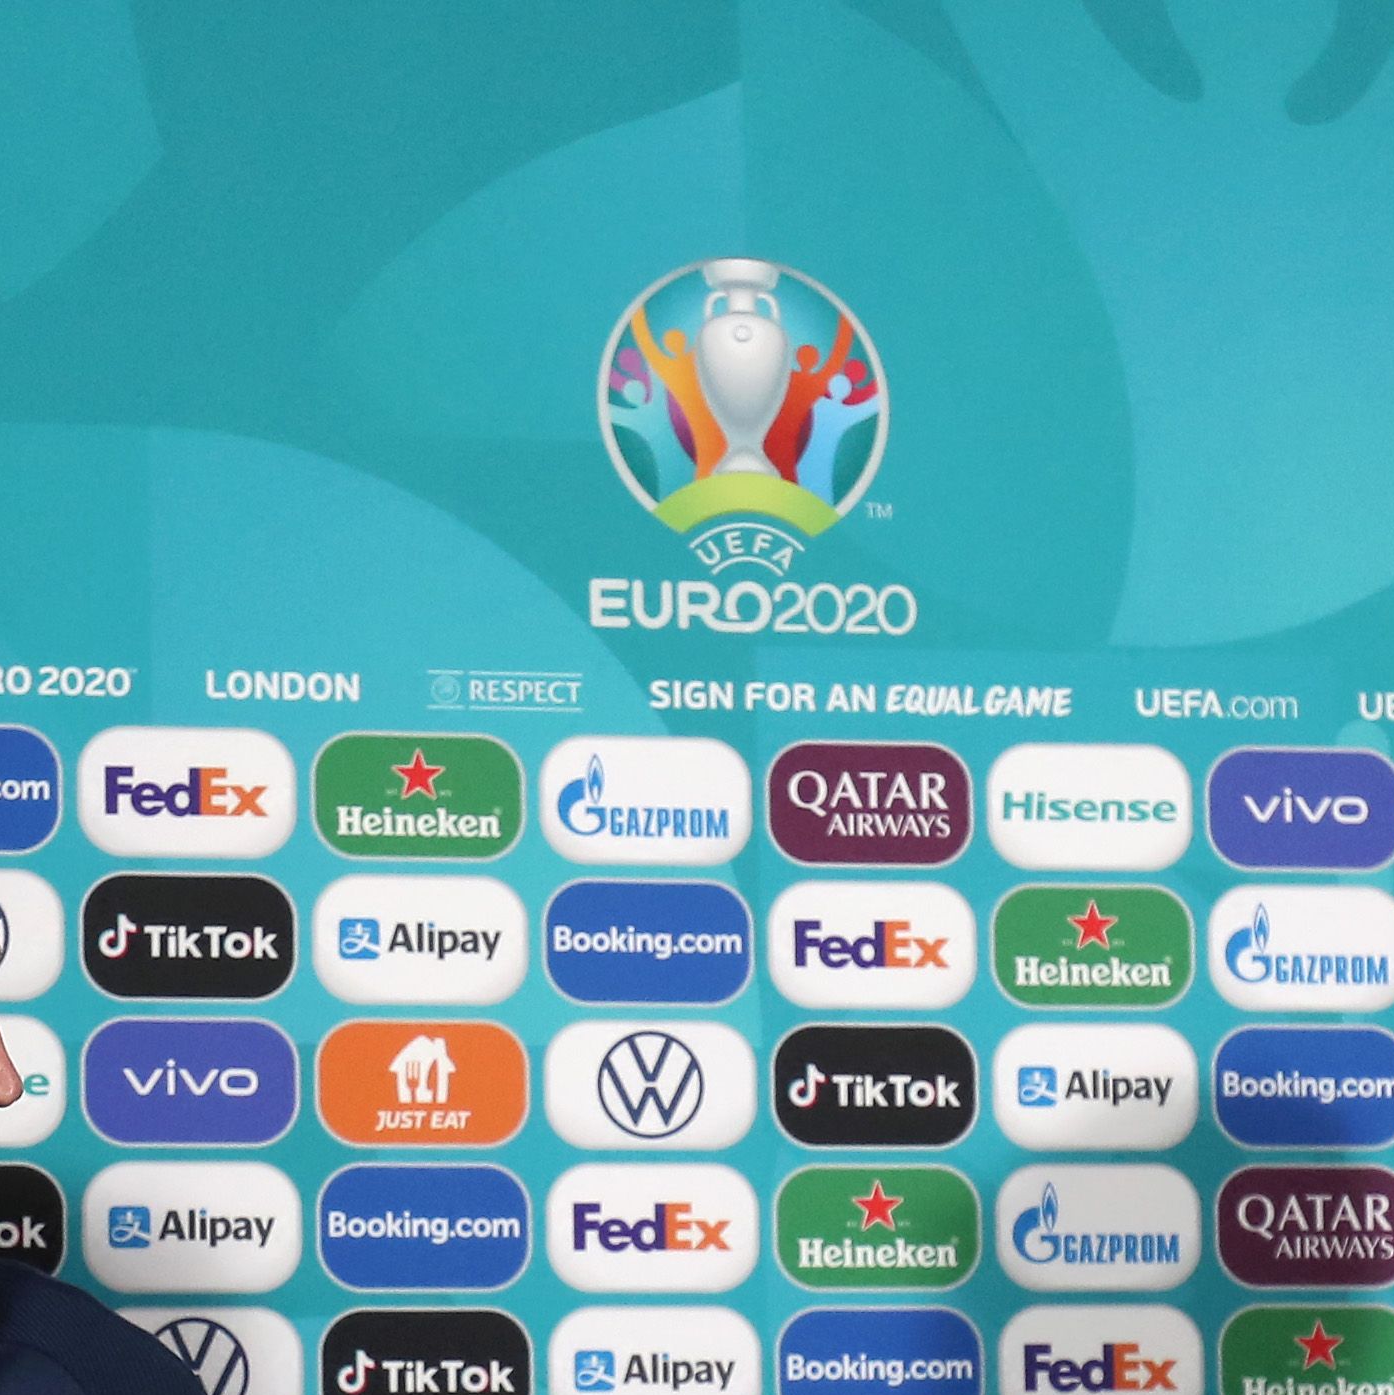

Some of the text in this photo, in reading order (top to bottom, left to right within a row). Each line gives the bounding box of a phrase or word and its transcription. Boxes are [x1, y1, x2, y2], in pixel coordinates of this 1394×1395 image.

[696, 532, 794, 570] UEFA
[38, 666, 130, 696] 2020
[207, 670, 359, 701] LONDON
[468, 679, 582, 704] RESPECT
[649, 680, 1071, 716] SIGN FOR AN EQUAL GAME
[1136, 689, 1297, 718] UEFA.com
[105, 766, 269, 817] FedEx
[788, 771, 948, 817] QATAR
[1003, 791, 1177, 822] Hisense
[337, 806, 497, 837] Heineken
[610, 807, 729, 838] GAZPROM
[828, 813, 950, 837] AIRWAYS
[1244, 794, 1368, 824] vivo
[144, 925, 278, 959] TikTok
[388, 923, 501, 960] Alipay
[554, 926, 742, 959] Booking.com
[794, 920, 946, 969] FedEx
[1015, 957, 1171, 986] Heineken
[1275, 955, 1388, 985] GAZPROM
[123, 1059, 258, 1096] vivo
[832, 1075, 960, 1107] TikTok
[1065, 1066, 1172, 1107] Alipay
[376, 1110, 471, 1131] JUST EAT
[159, 1210, 274, 1247] Alipay
[328, 1211, 520, 1244] Booking.com
[573, 1203, 728, 1252] FedEx
[1237, 1194, 1393, 1241] QATAR
[799, 1238, 956, 1268] Heineken
[1064, 1234, 1179, 1263] GAZPROM
[1276, 1235, 1394, 1259] AIRWAYS
[382, 1360, 514, 1393] TikTok
[624, 1353, 734, 1390] Alipay
[786, 1353, 972, 1386] Booking.com
[1024, 1343, 1175, 1393] FedEx
